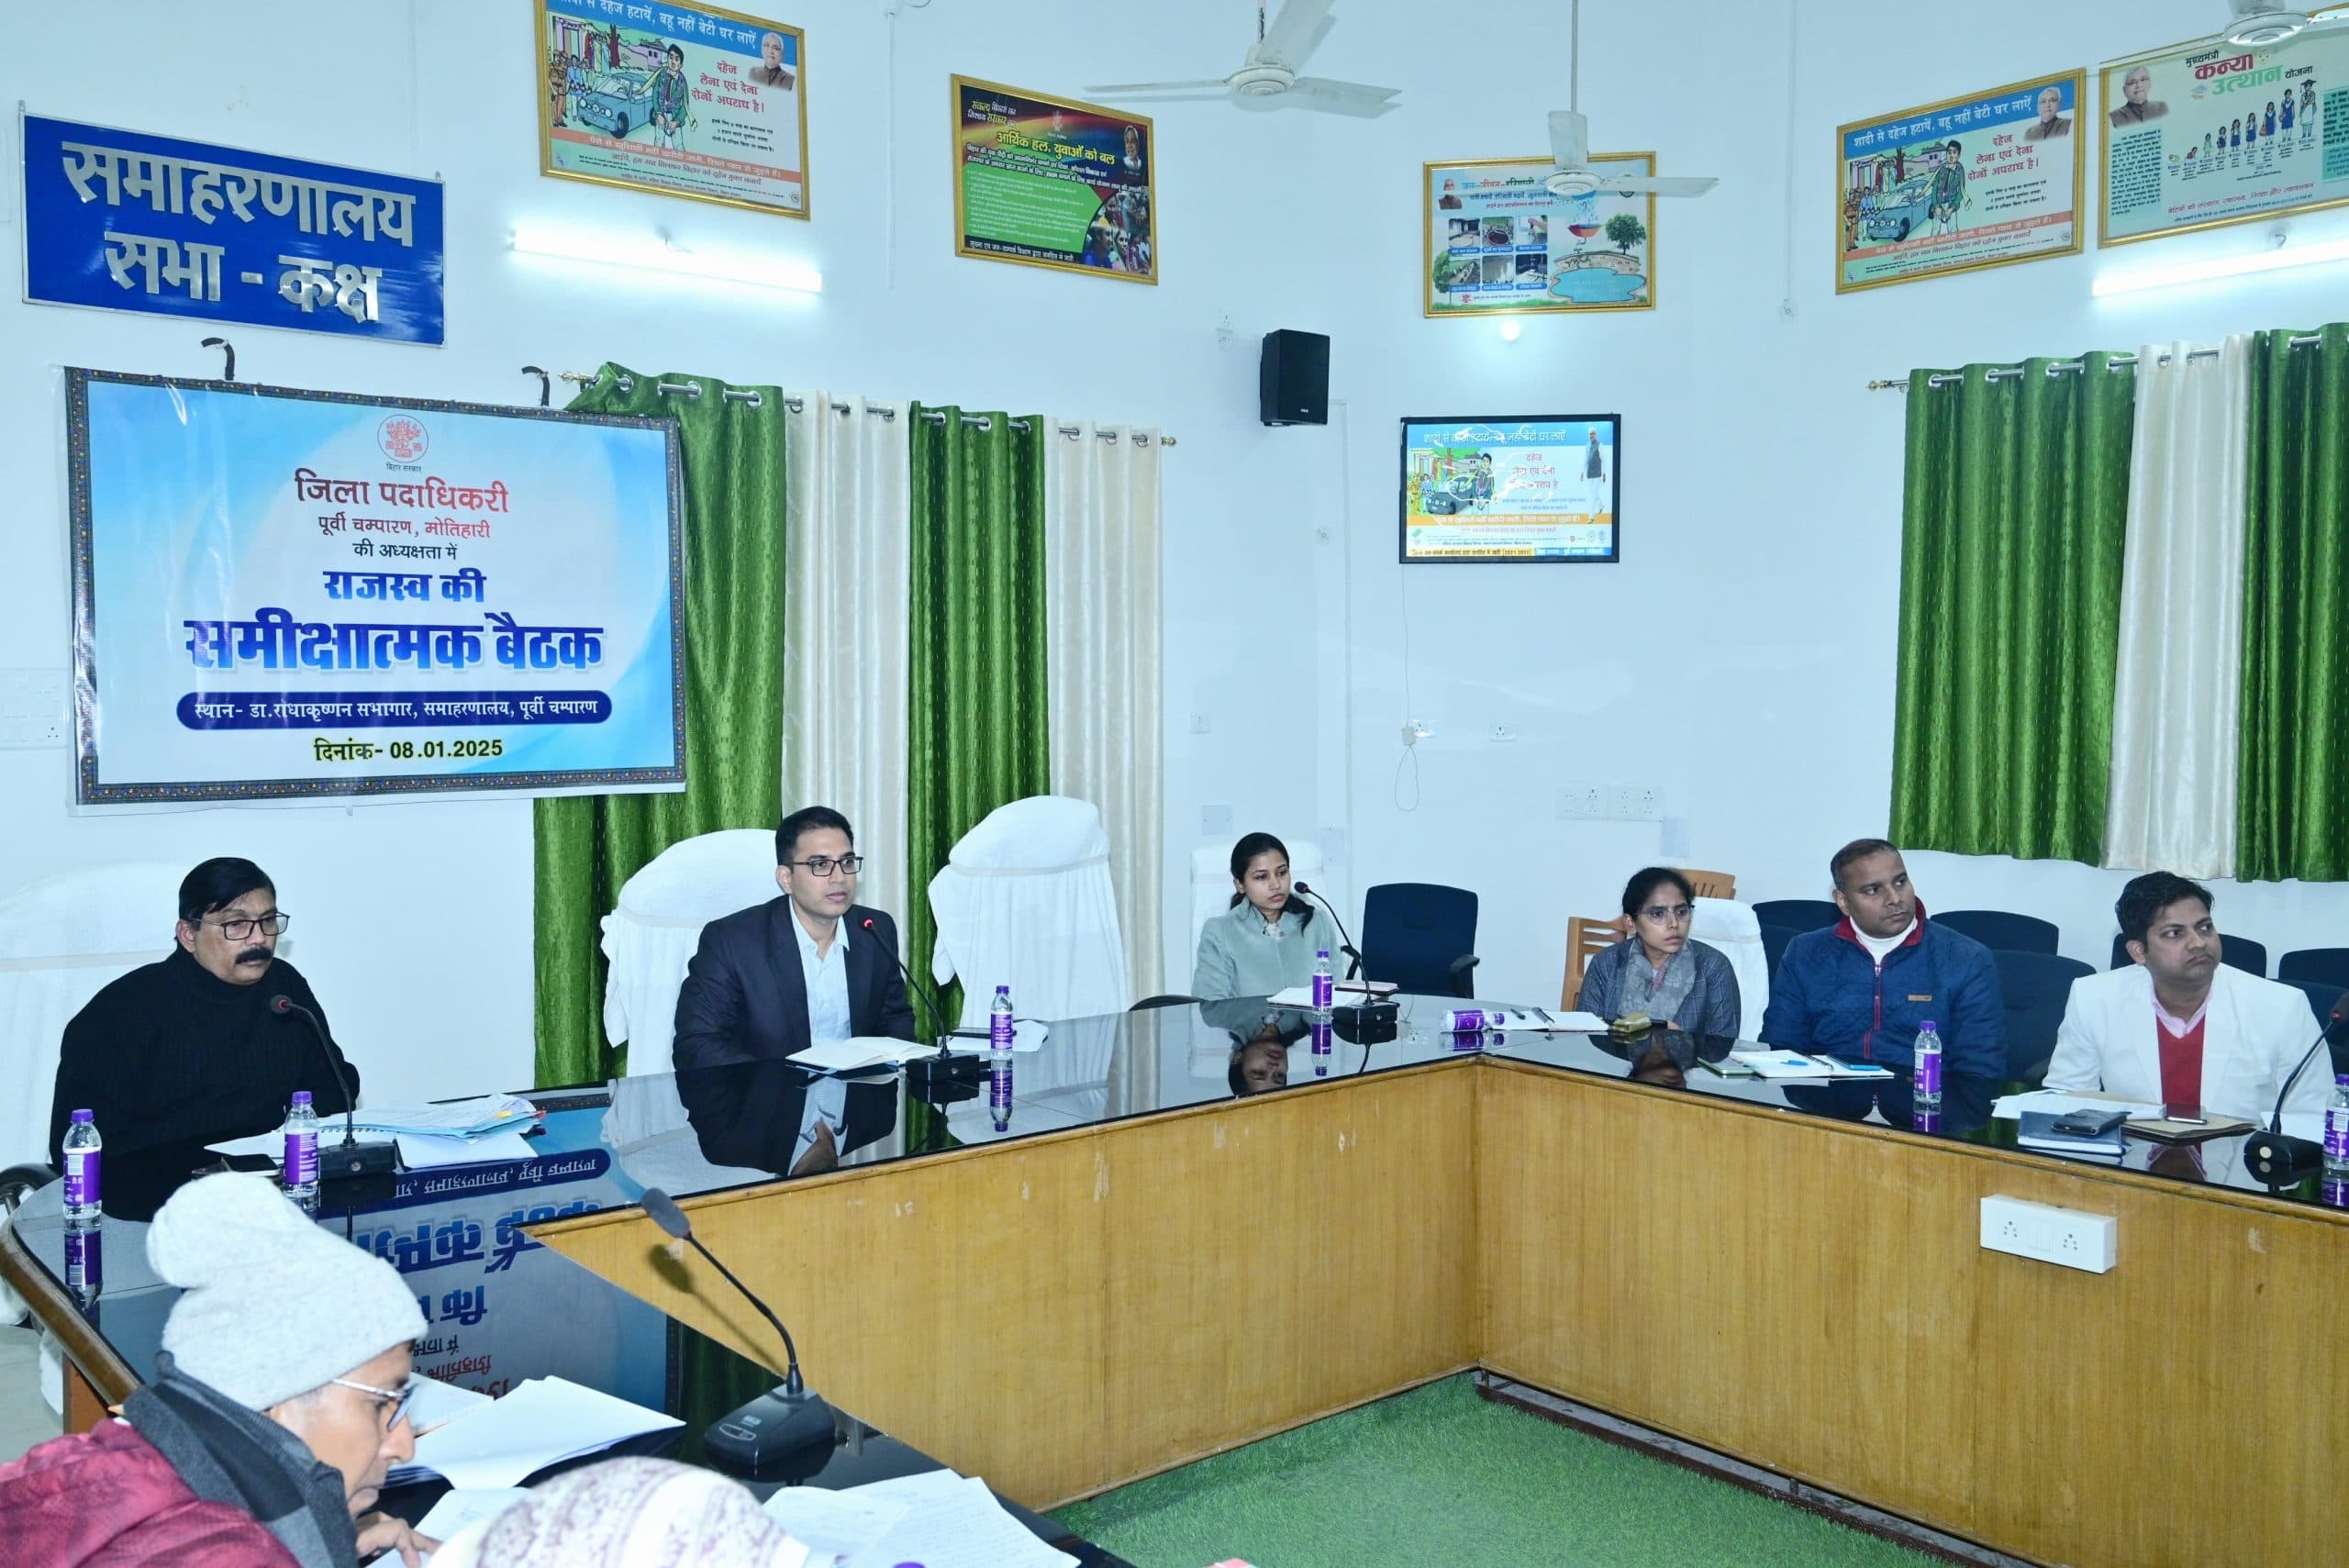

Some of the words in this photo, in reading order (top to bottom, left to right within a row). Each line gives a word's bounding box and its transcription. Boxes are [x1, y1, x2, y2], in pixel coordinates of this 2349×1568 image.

[600, 0, 623, 15] दहज
[659, 12, 674, 32] बहू
[677, 15, 696, 31] नहीं
[698, 18, 716, 37] बेटी
[719, 27, 734, 41] घर
[717, 61, 737, 73] दहेज
[2186, 50, 2219, 67] मुख्यमंत्री
[2195, 53, 2254, 80] कन्या
[700, 72, 719, 87] लेना
[724, 79, 737, 92] एवं
[740, 81, 759, 95] देना
[2212, 65, 2283, 95] उत्थान
[2285, 65, 2313, 79] योजना
[691, 88, 712, 102] दोनों
[717, 95, 750, 109] अपराध
[1854, 131, 1875, 147] शादी
[1876, 128, 1884, 141] से
[1887, 125, 1907, 139] दहेज
[1938, 115, 1953, 131] बहू
[1954, 109, 1971, 124] नहीं
[1974, 104, 1990, 119] बेटी
[1994, 103, 2009, 116] घर
[996, 131, 1029, 147] आर्थिक
[1032, 139, 1052, 153] हल,
[1054, 143, 1084, 159] युवाओं
[1085, 148, 1097, 161] को
[1100, 152, 1116, 165] बल
[1992, 134, 2013, 147] दहेज
[1976, 153, 1996, 164] लेना
[1999, 147, 2012, 161] एवं
[2015, 145, 2033, 156] देना
[1967, 166, 1987, 181] दोनों
[1991, 161, 2024, 175] अपराध
[61, 140, 416, 248] समाहरणालय
[105, 231, 225, 302] सभा
[279, 254, 382, 323] कक्ष
[385, 462, 401, 472] बिहार
[403, 464, 422, 473] सरकार
[295, 468, 370, 505] जिला
[379, 476, 511, 512] पदाधिकरी
[317, 511, 346, 536] पूर्वी
[352, 517, 419, 537] चम्पारण,
[425, 517, 491, 539] मोतिहारी
[352, 538, 373, 557] की
[379, 543, 441, 560] अध्यक्षता
[445, 543, 458, 560] में
[322, 571, 433, 601] राजस्व
[440, 567, 487, 603] की
[184, 607, 484, 669] समीक्षात्मक
[484, 612, 604, 669] बैठक
[195, 703, 243, 718] स्थान-
[250, 703, 352, 722] डा.राधाकृष्णन
[357, 702, 417, 720] सभागार,
[423, 701, 515, 717] समाहरणालय,
[519, 696, 544, 720] पूर्वी
[549, 700, 598, 715] चम्पारण
[314, 738, 383, 762] दिनांक-
